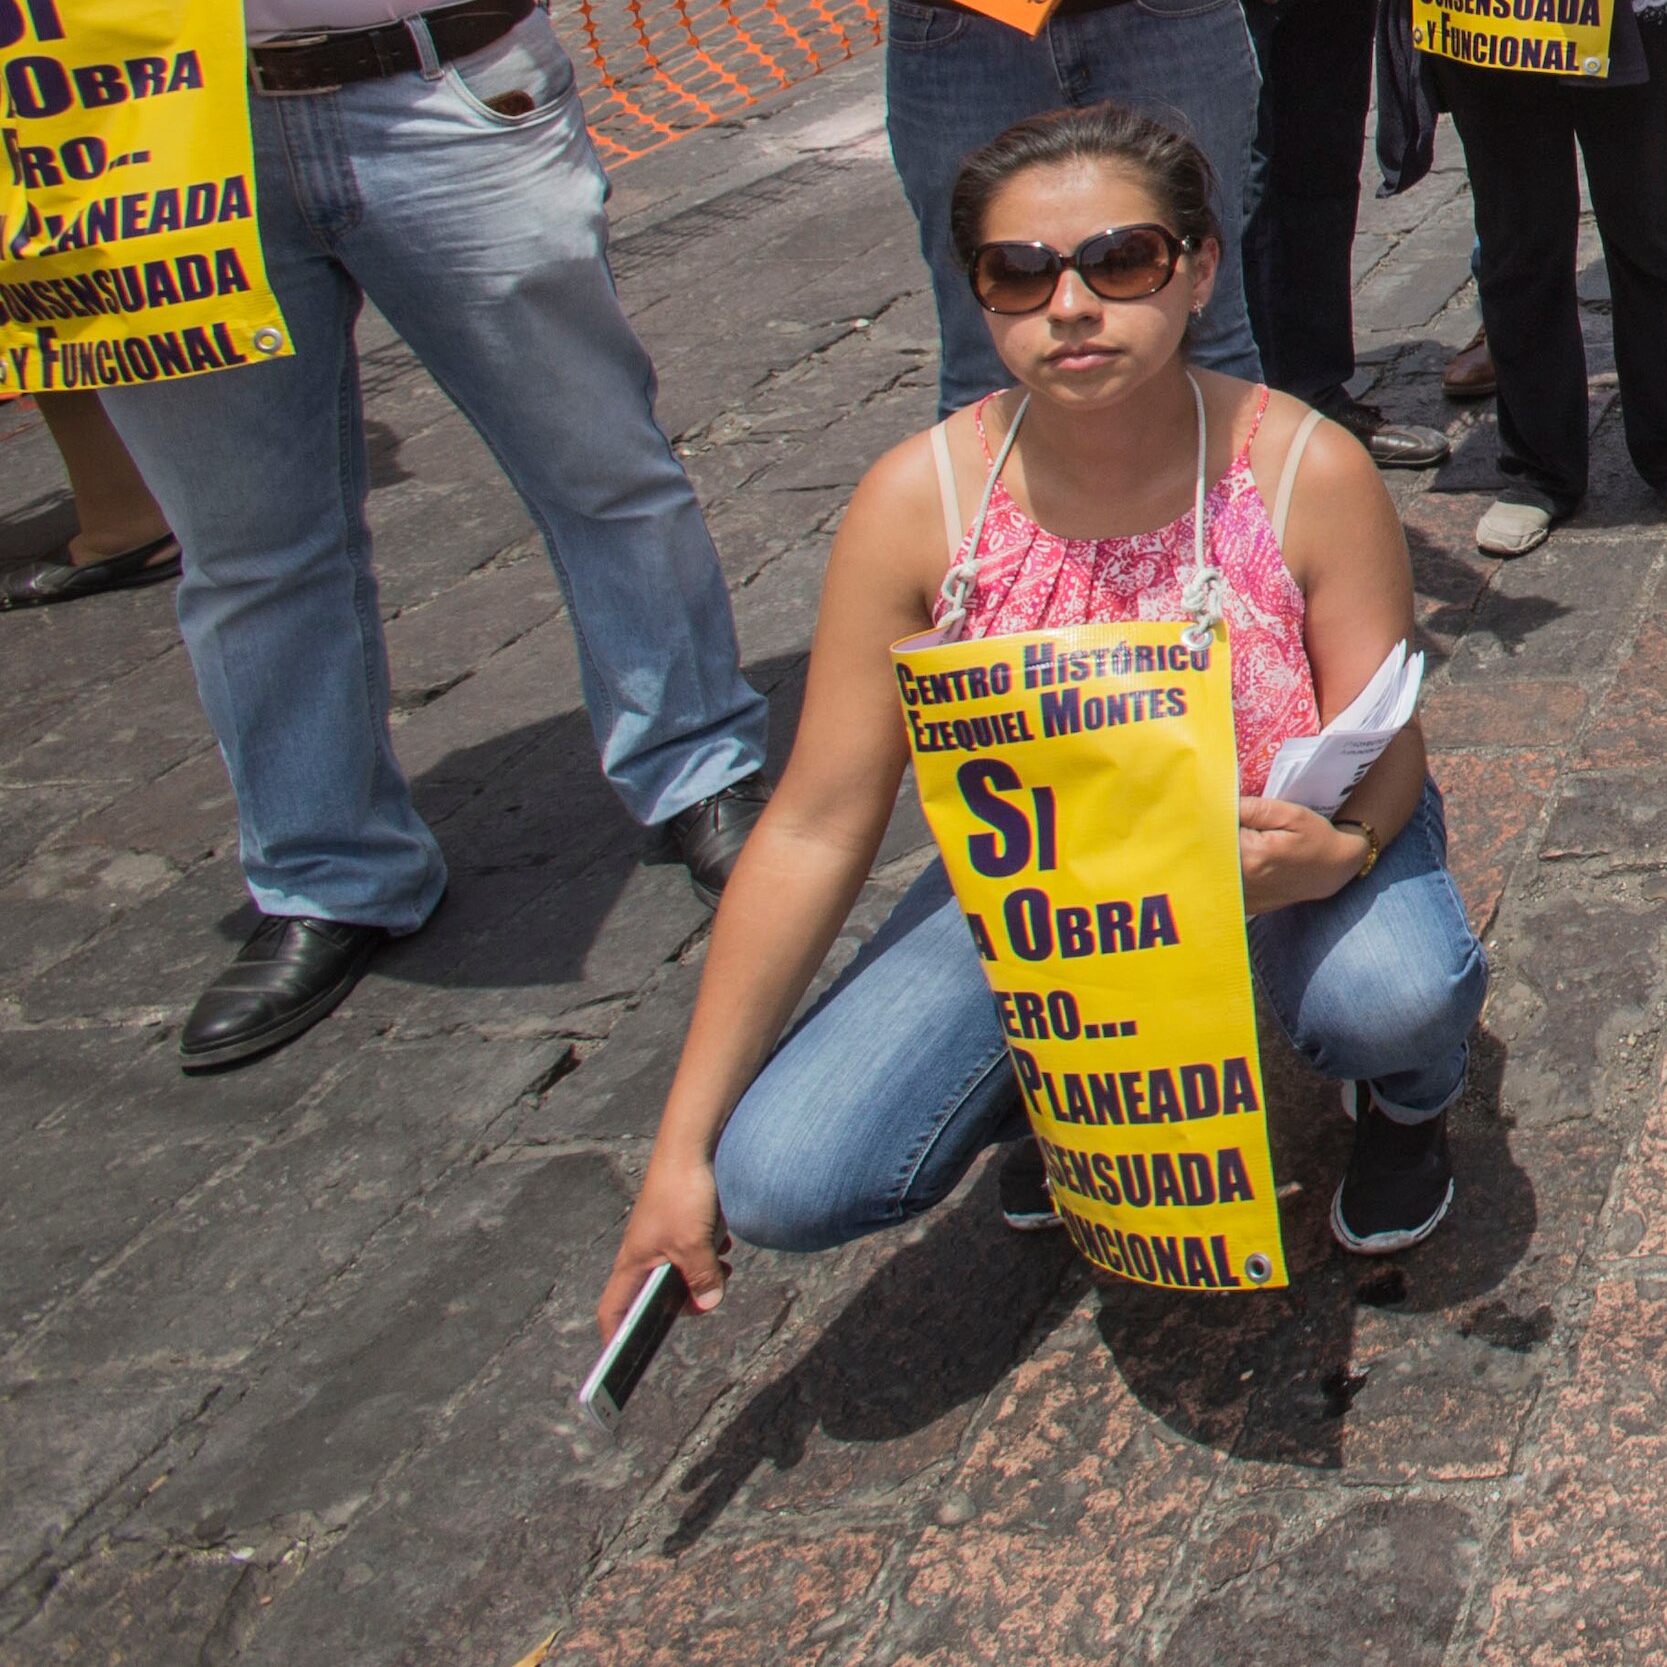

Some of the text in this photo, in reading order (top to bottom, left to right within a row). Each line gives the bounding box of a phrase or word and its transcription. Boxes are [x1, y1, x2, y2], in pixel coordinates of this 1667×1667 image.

[1426, 16, 1581, 73] Y FUNCIONAL
[5, 49, 205, 119] OBRA
[0, 247, 252, 326] ONSENSUADA
[10, 321, 249, 390] Y FUNCIONAL
[895, 641, 1211, 707] CENTRO HISTÓRICO
[907, 687, 1188, 753] EZEQUIEL MONTES
[1003, 887, 1181, 963] OBRA
[994, 990, 1139, 1041] ERO...
[1010, 1044, 1262, 1126] PLANEADA
